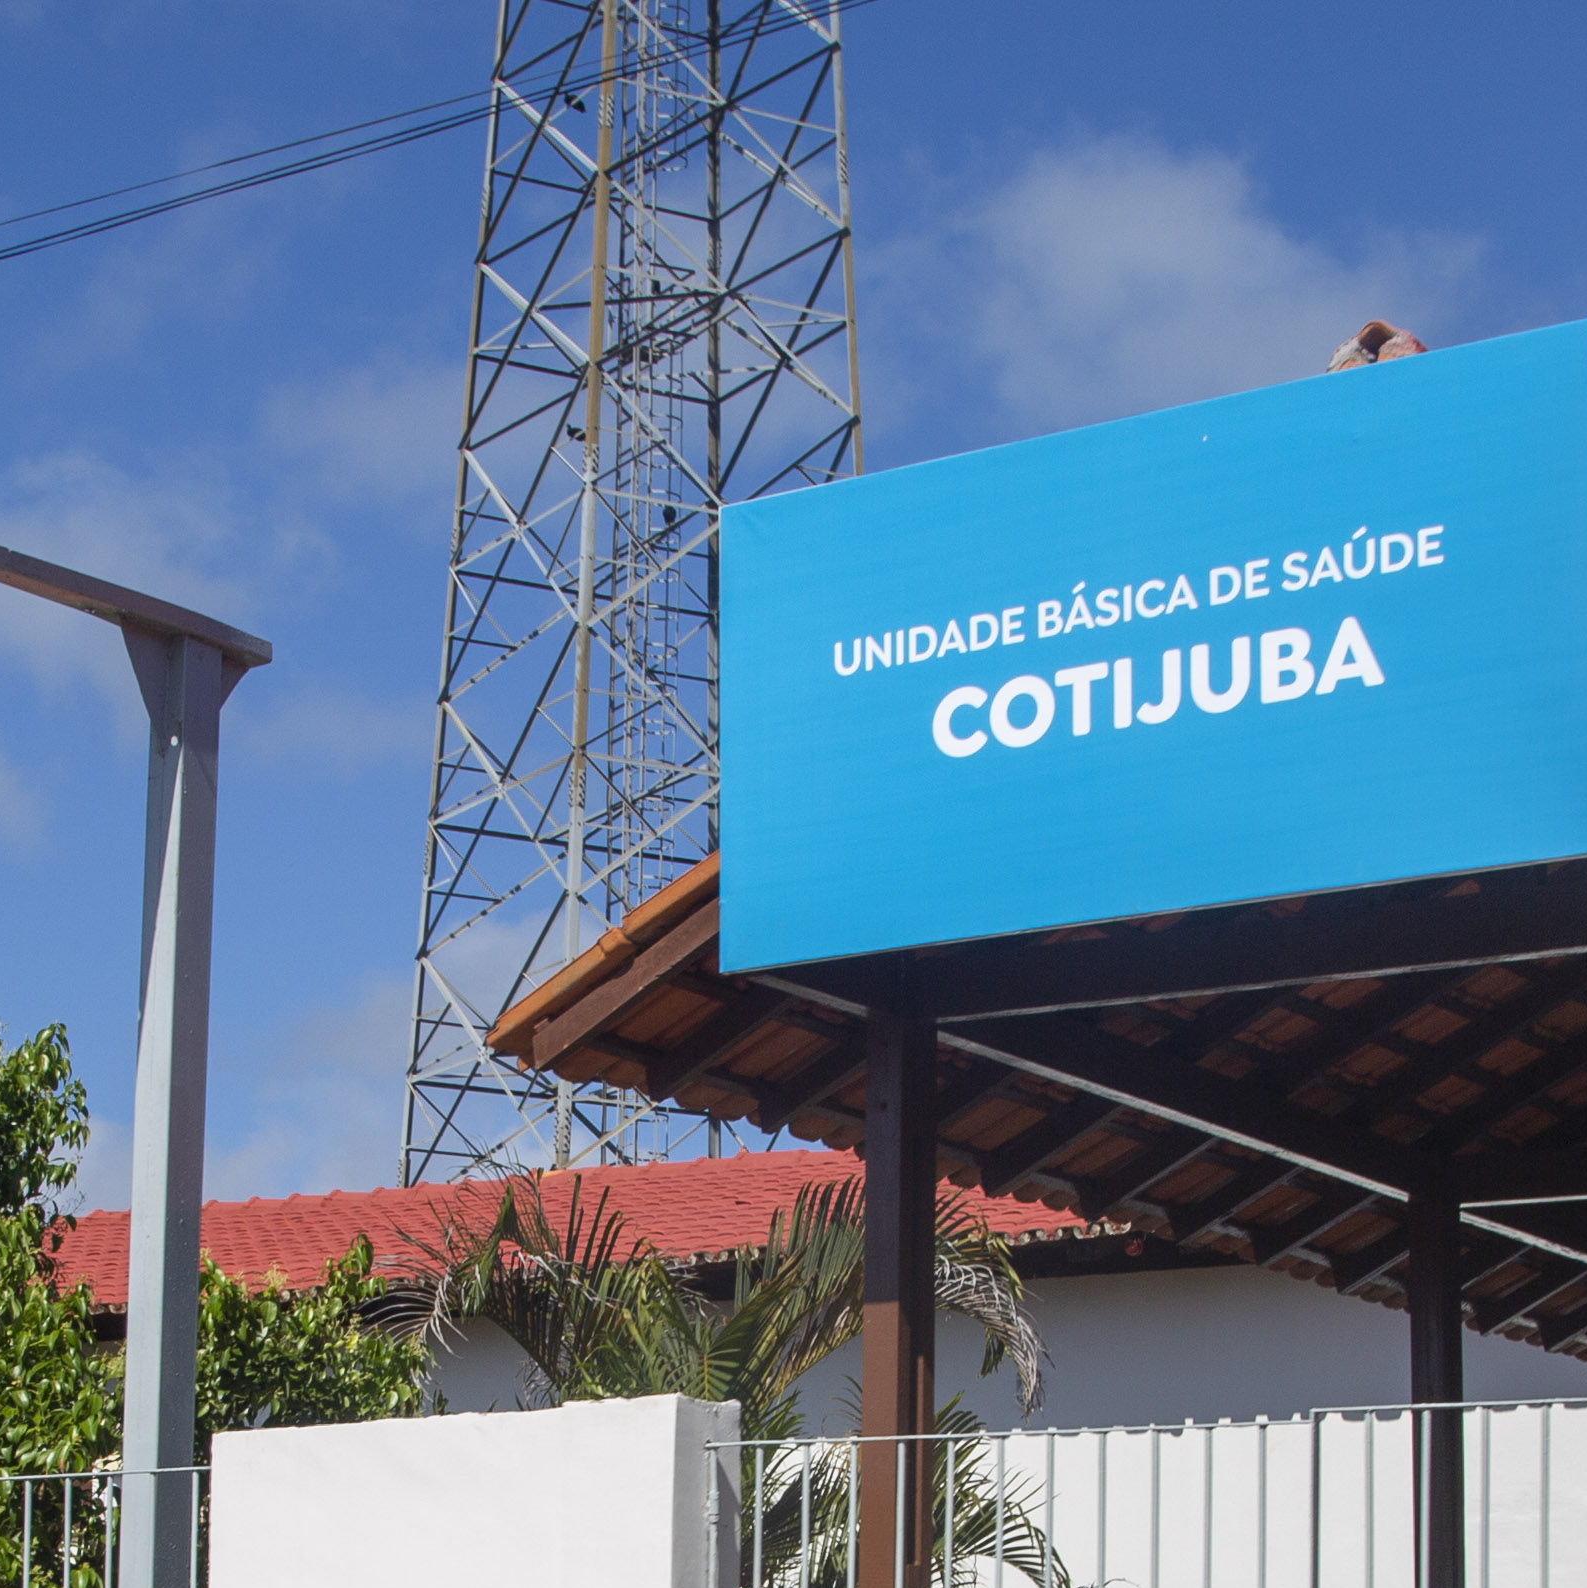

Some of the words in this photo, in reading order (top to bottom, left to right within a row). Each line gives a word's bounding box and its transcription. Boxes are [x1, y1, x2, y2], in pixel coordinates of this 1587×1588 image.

[833, 605, 1026, 676] UNIDADE
[1037, 580, 1199, 639] BÁSICA
[1209, 557, 1270, 606] DE
[1281, 525, 1445, 591] SAÚDE
[931, 615, 1386, 758] COTIJUBA
